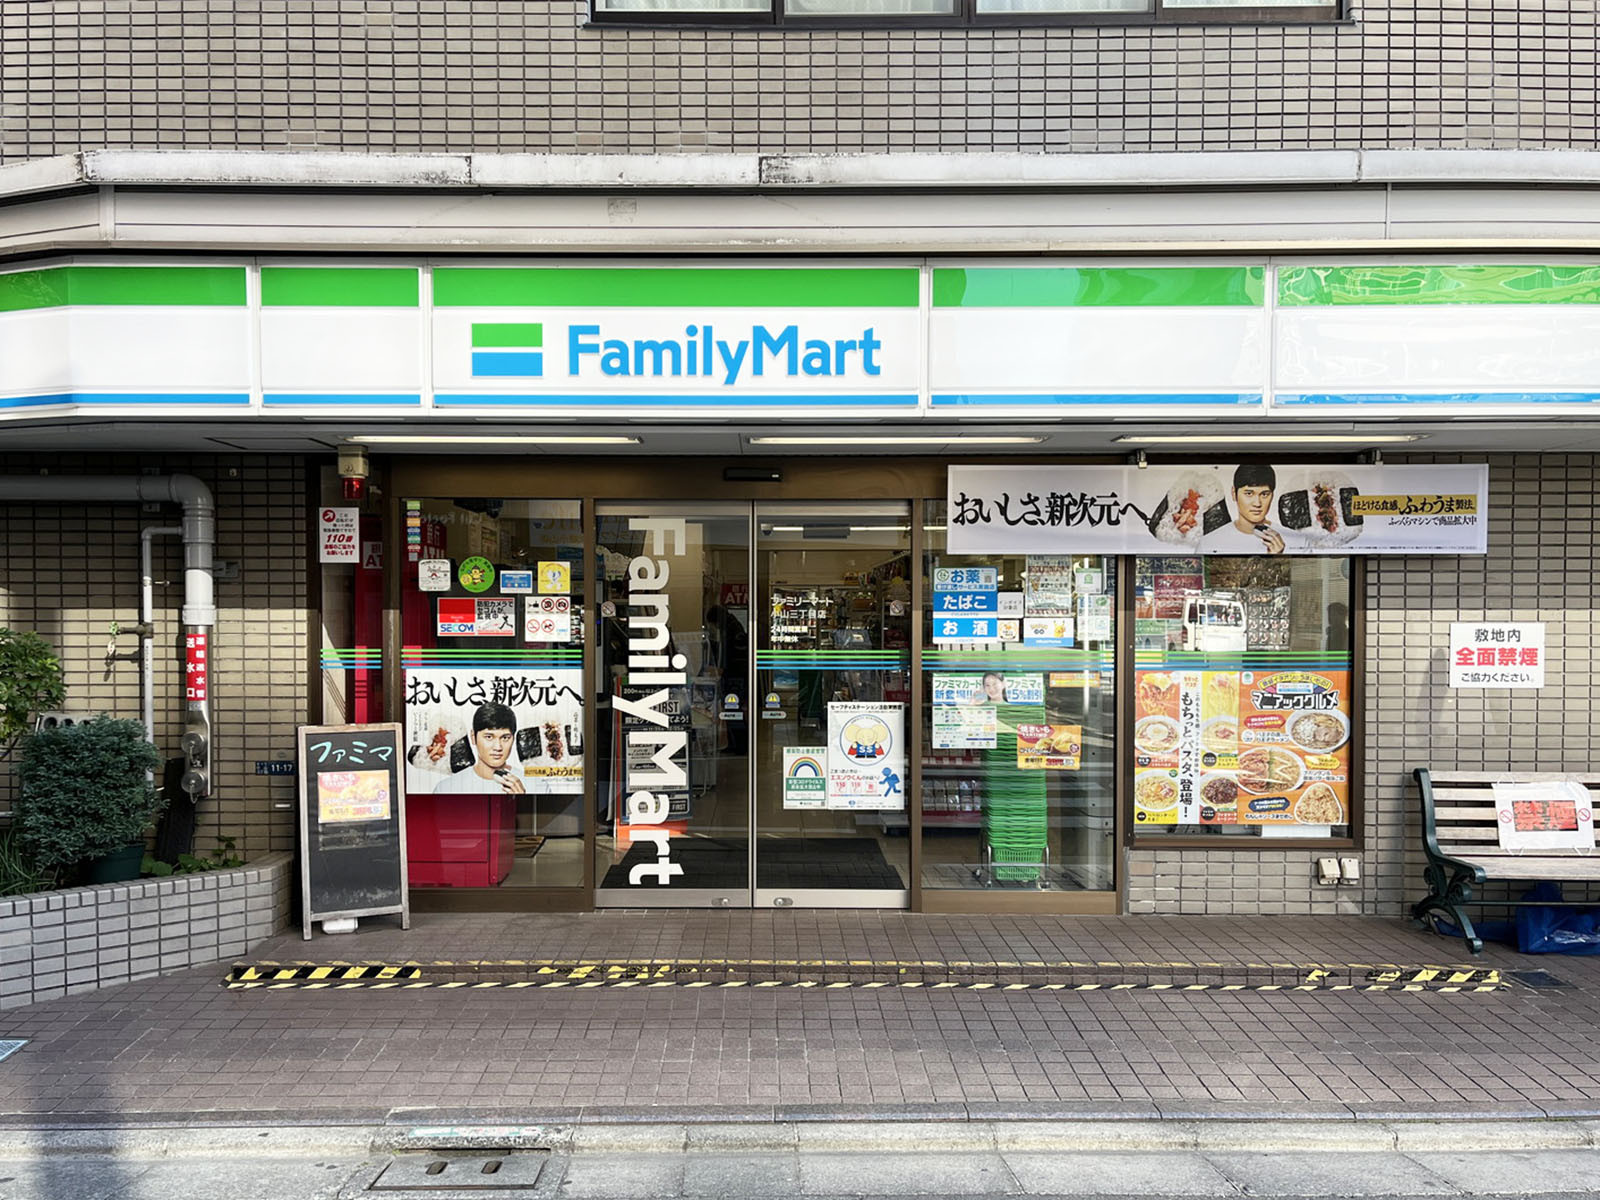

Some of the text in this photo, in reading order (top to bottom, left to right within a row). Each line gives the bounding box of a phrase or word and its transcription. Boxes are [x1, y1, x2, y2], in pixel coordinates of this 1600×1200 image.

[568, 324, 881, 385] FamilyMart
[770, 596, 834, 607] ファミリーマート
[943, 595, 987, 610] たばこ
[440, 624, 474, 632] SECOM
[1474, 628, 1521, 643] 敷地内
[1455, 647, 1539, 667] 全面禁煙
[612, 518, 687, 885] FamilyMart
[1252, 690, 1339, 710] マニアックグルメ
[310, 741, 393, 764] ファミマ
